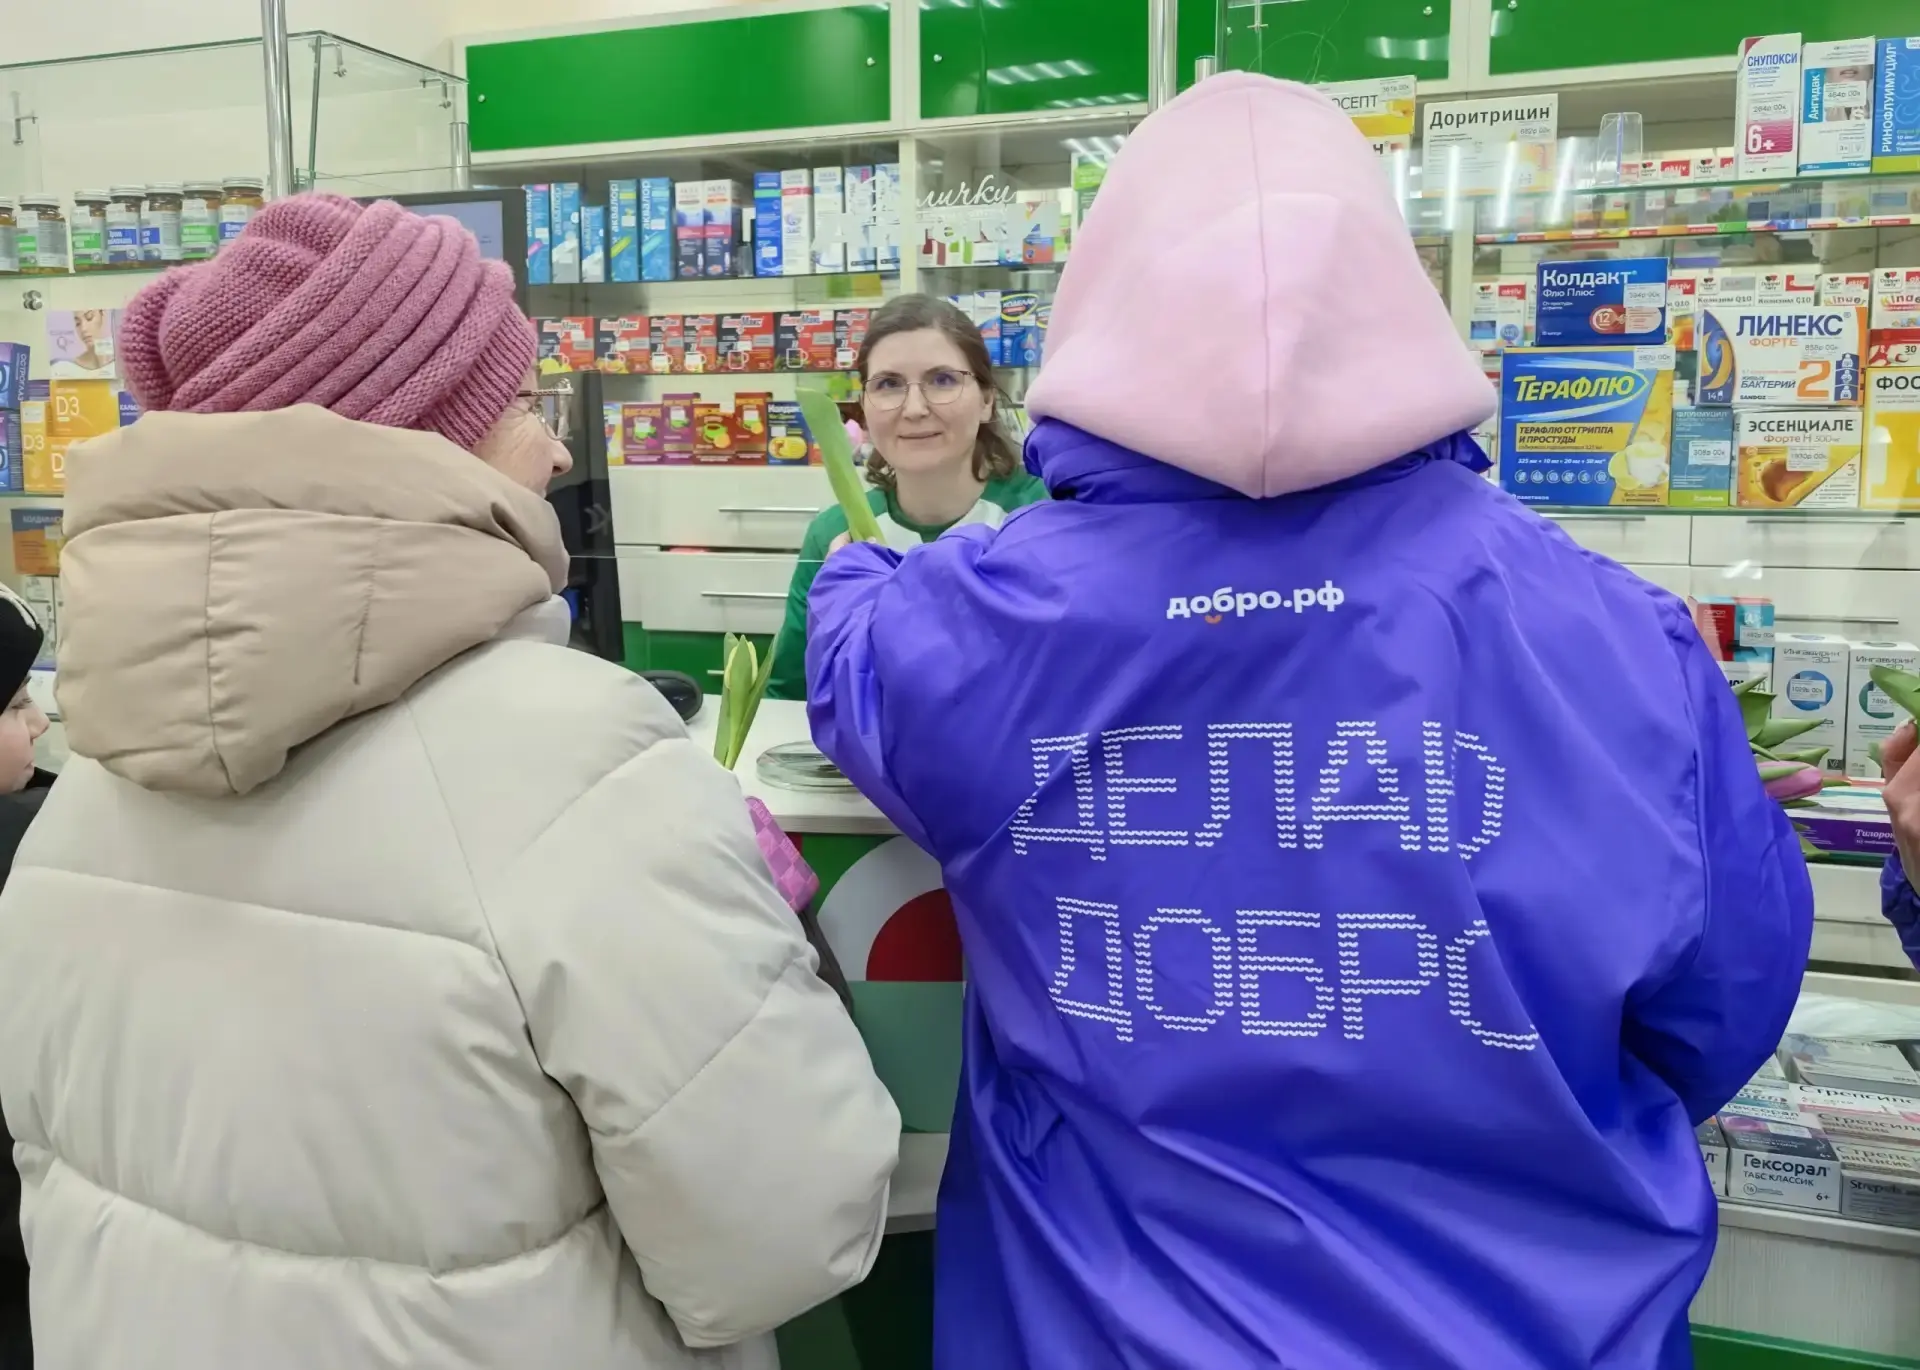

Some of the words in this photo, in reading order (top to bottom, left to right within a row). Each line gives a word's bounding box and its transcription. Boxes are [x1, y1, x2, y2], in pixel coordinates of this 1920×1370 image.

[1747, 53, 1798, 67] СНУПОКСИ
[1808, 73, 1820, 120] Ангидак
[1882, 46, 1897, 152] РИНОФЛУИМУЦИЛ
[1429, 107, 1550, 130] Доритрицин
[1748, 125, 1775, 152] 6+
[1542, 270, 1631, 288] Колдакт
[1542, 288, 1565, 297] Флю
[1567, 288, 1595, 297] Плюс
[1599, 313, 1610, 323] 12
[1736, 314, 1844, 337] ЛИНЕКС
[1749, 337, 1799, 347] ФОРТЕ
[1740, 380, 1797, 389] БАКТЕРИЙ
[1797, 360, 1831, 397] 2
[1513, 375, 1635, 402] ТЕРАФЛЮ
[1707, 392, 1717, 400] 14
[56, 396, 79, 416] D3
[1748, 419, 1854, 434] ЭССЕНЦИАЛЕ
[23, 434, 45, 450] D3
[1526, 436, 1577, 444] ПРОСТУДЫ
[1763, 434, 1801, 444] Форте
[1847, 463, 1857, 476] 3
[1166, 580, 1344, 619] добро.рф
[1783, 648, 1840, 657] Ингавирин
[1855, 655, 1915, 664] Ингавирин
[1743, 1153, 1828, 1177] Гексорал
[1743, 1170, 1767, 1181] ТАБС
[1768, 1174, 1815, 1187] КЛАССИК
[1816, 1193, 1830, 1201] 6+
